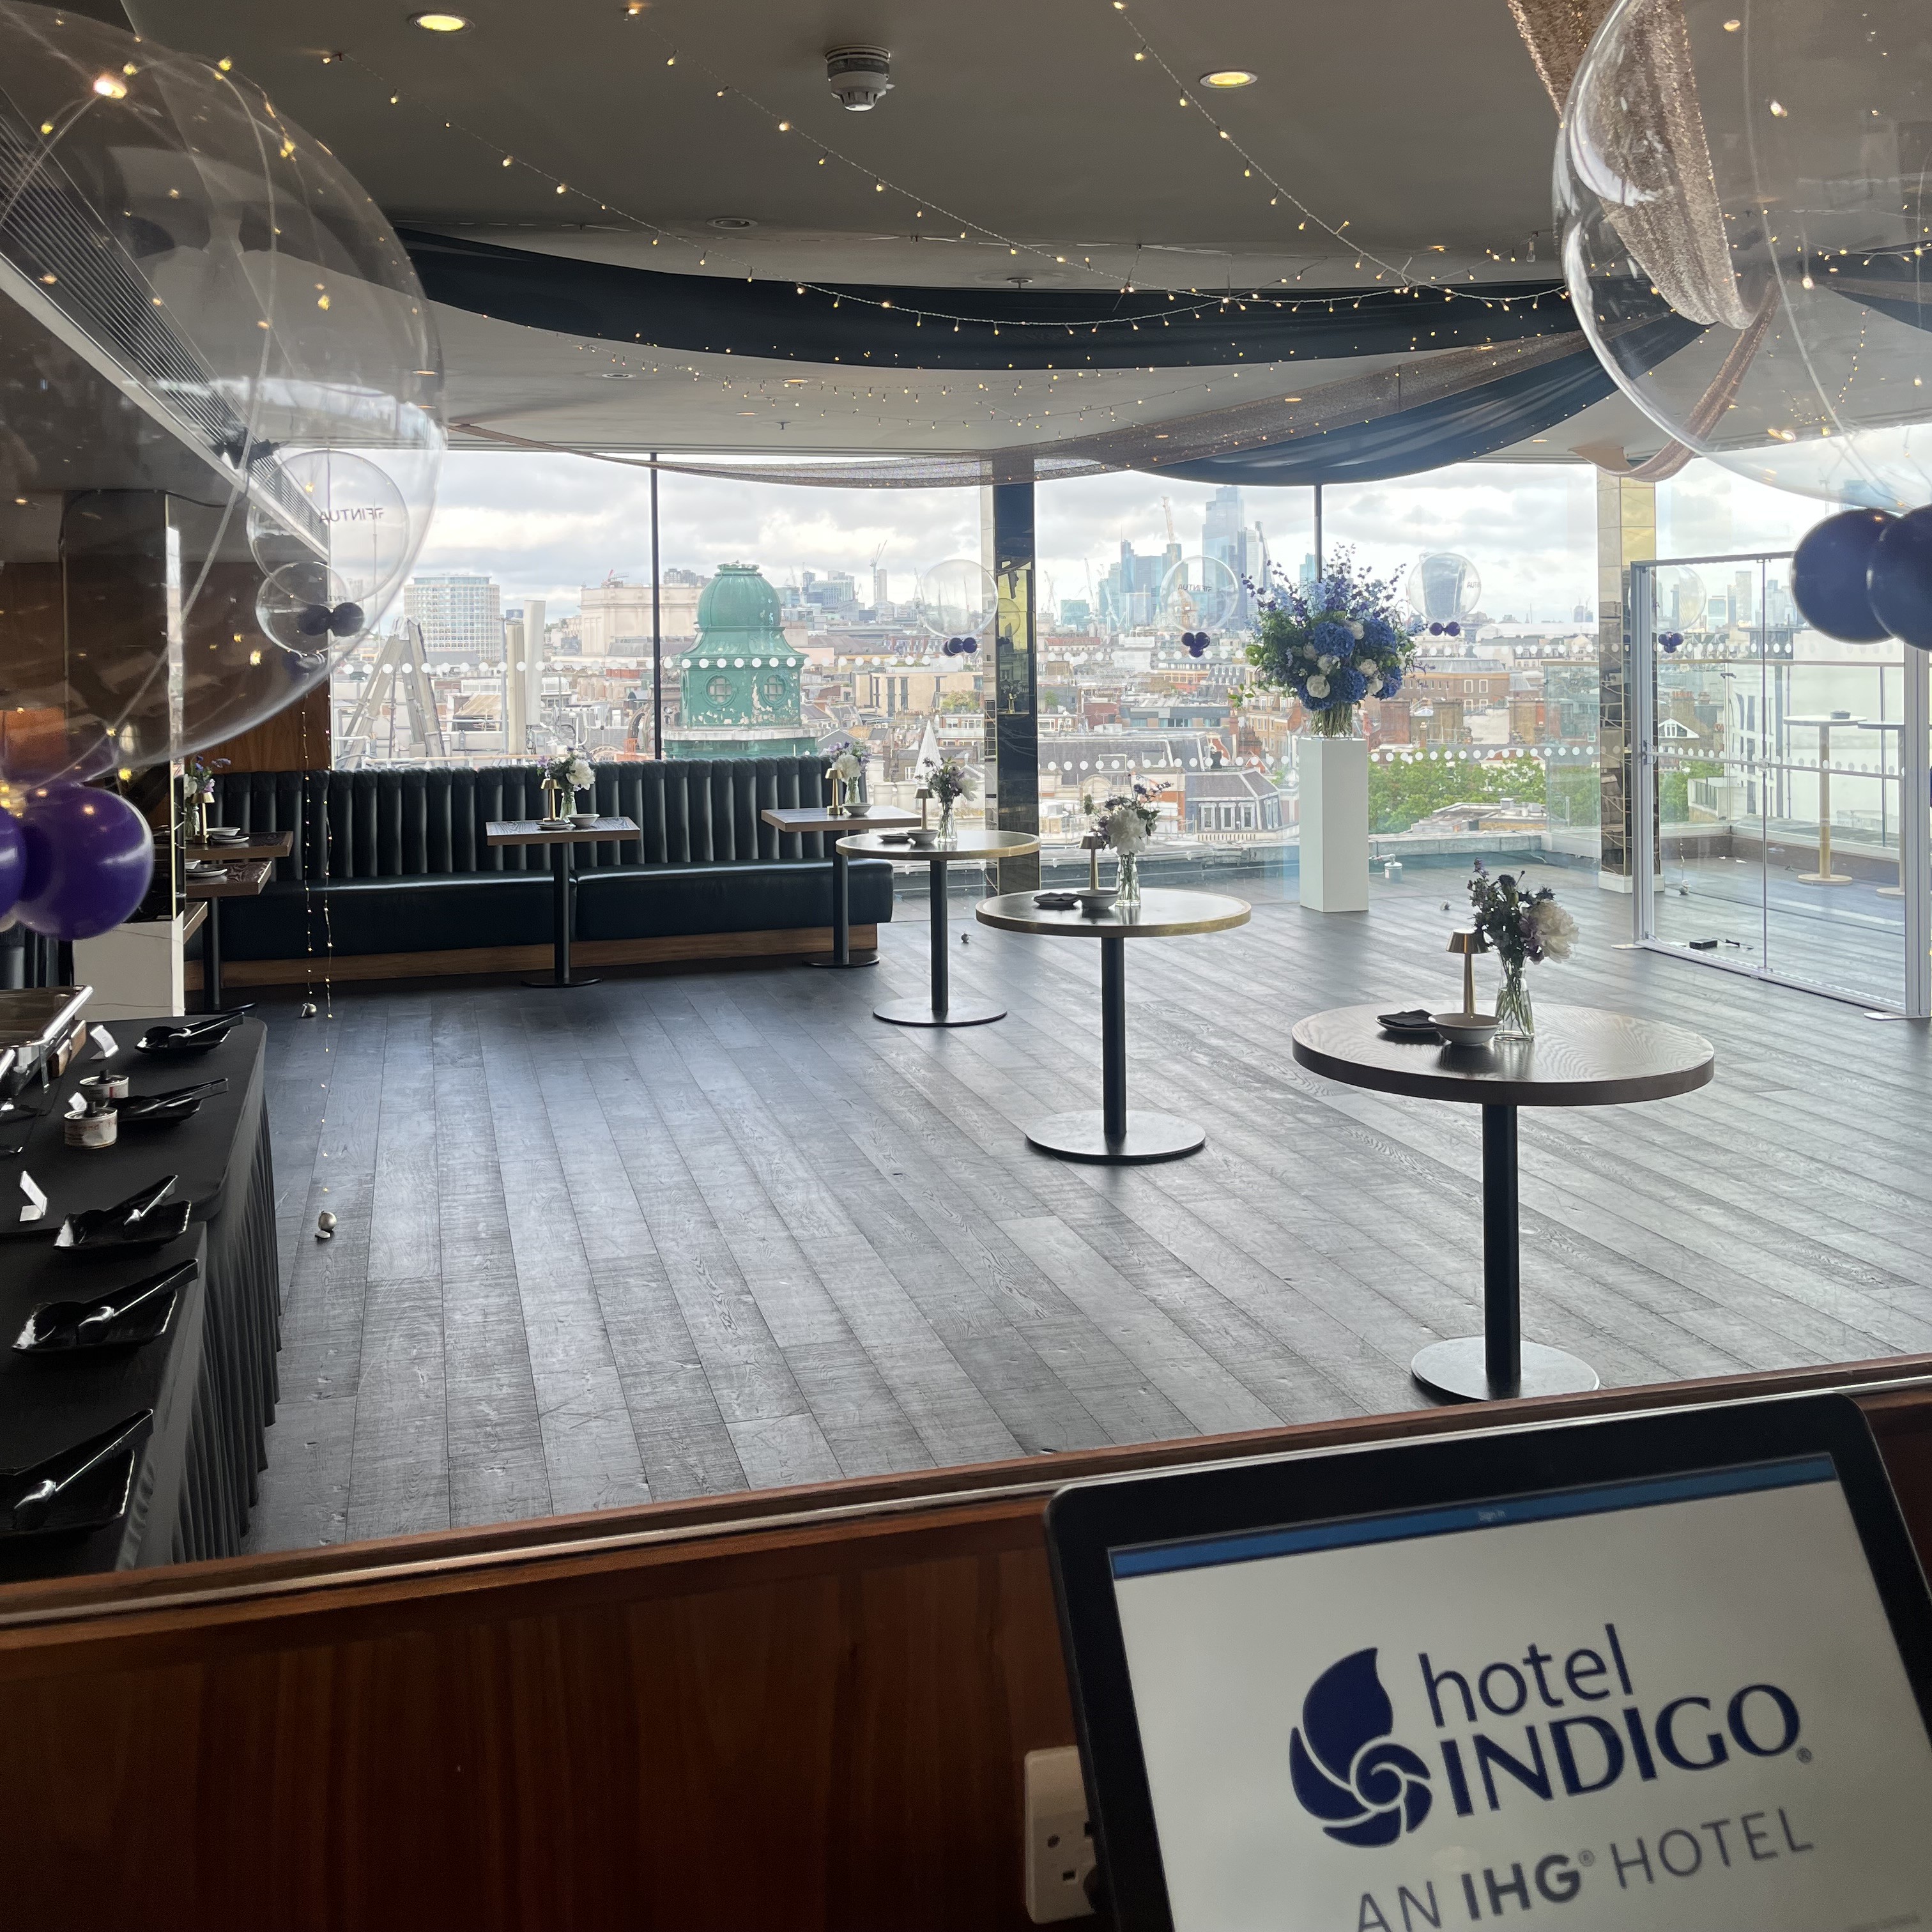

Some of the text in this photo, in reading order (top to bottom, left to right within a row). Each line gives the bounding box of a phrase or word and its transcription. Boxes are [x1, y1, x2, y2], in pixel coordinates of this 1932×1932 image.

[1418, 1623, 1634, 1728] hotel
[1356, 1880, 1442, 1932] AN
[1611, 1807, 1814, 1889] HOTEL
